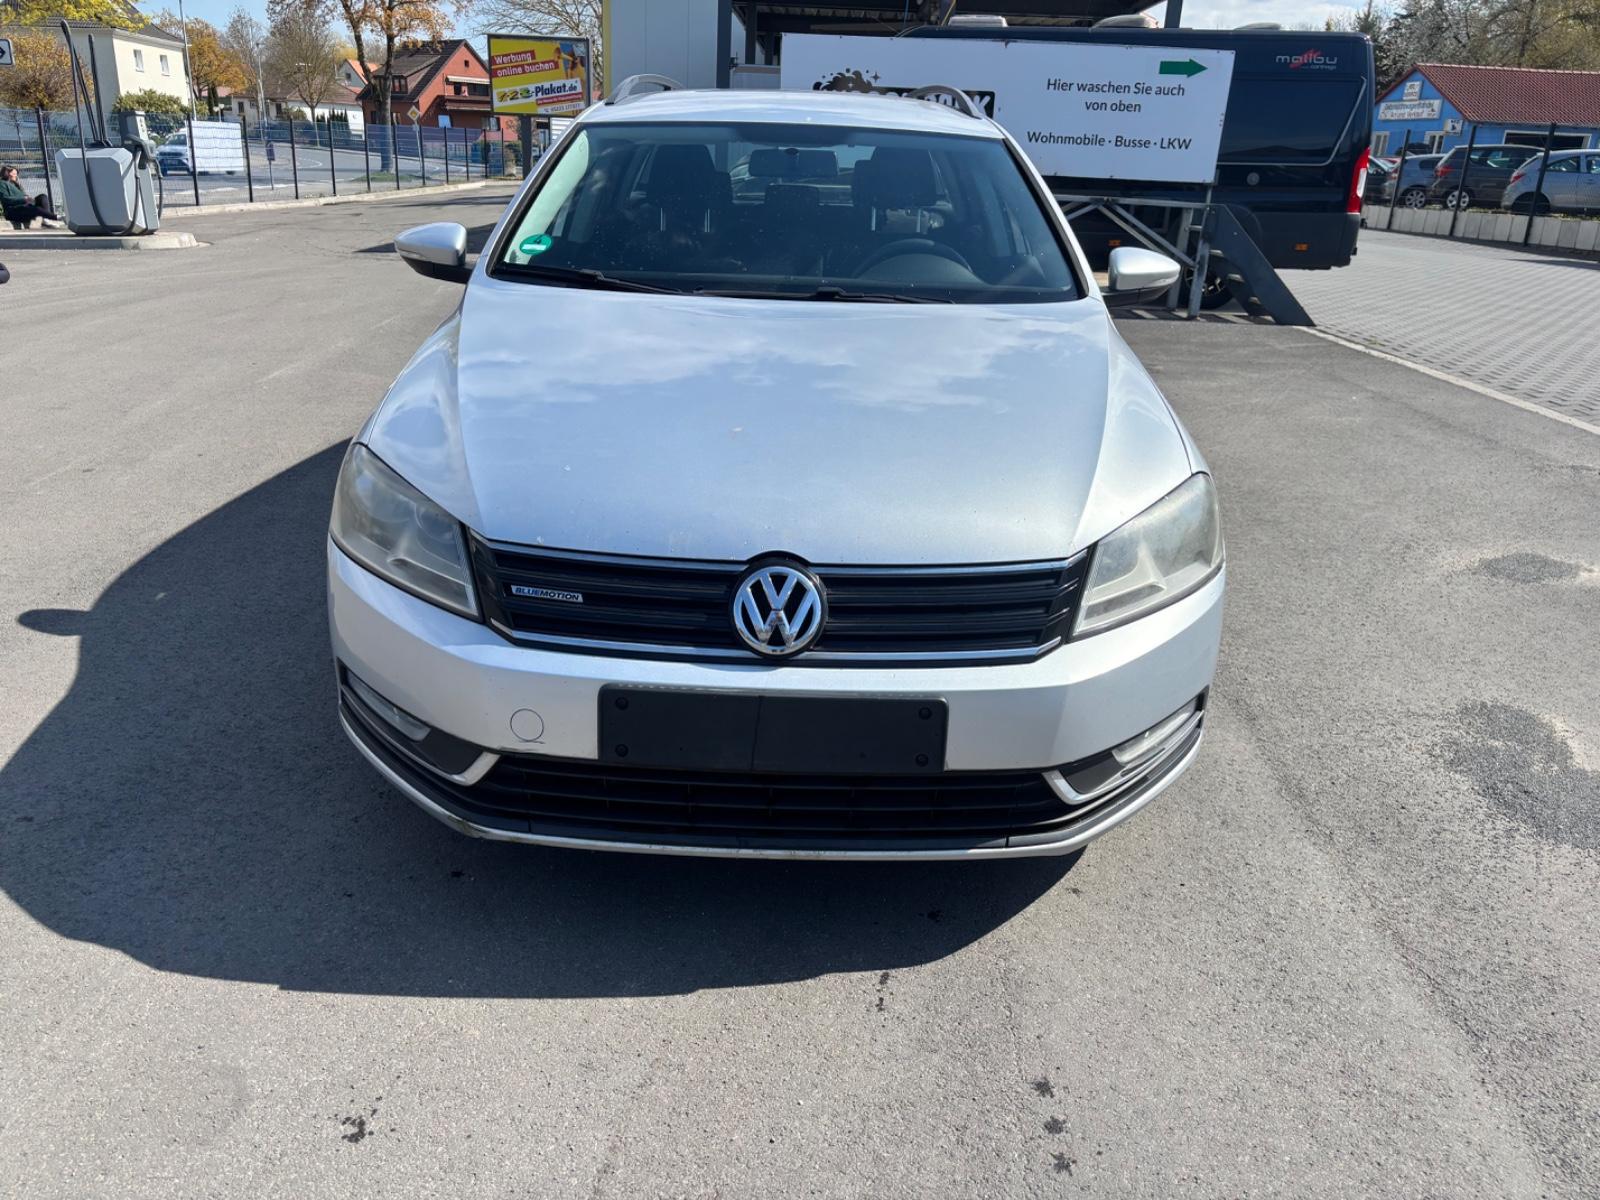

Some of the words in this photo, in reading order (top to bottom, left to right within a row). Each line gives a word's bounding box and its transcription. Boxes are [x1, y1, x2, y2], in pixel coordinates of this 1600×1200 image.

[495, 52, 532, 64] Werbung
[1275, 53, 1338, 64] malibu
[497, 66, 523, 77] online
[525, 62, 555, 73] buchen
[1046, 78, 1074, 92] Hier
[1076, 80, 1131, 94] waschen
[1133, 82, 1152, 95] Sie
[1154, 84, 1185, 96] auch
[1085, 101, 1107, 112] von
[1110, 100, 1142, 113] oben
[1027, 131, 1105, 147] Wohnmobile
[1114, 135, 1151, 149] Busse
[1160, 137, 1192, 150] LKW
[515, 587, 580, 601] BLUEMOTION
[735, 567, 821, 654] VW
